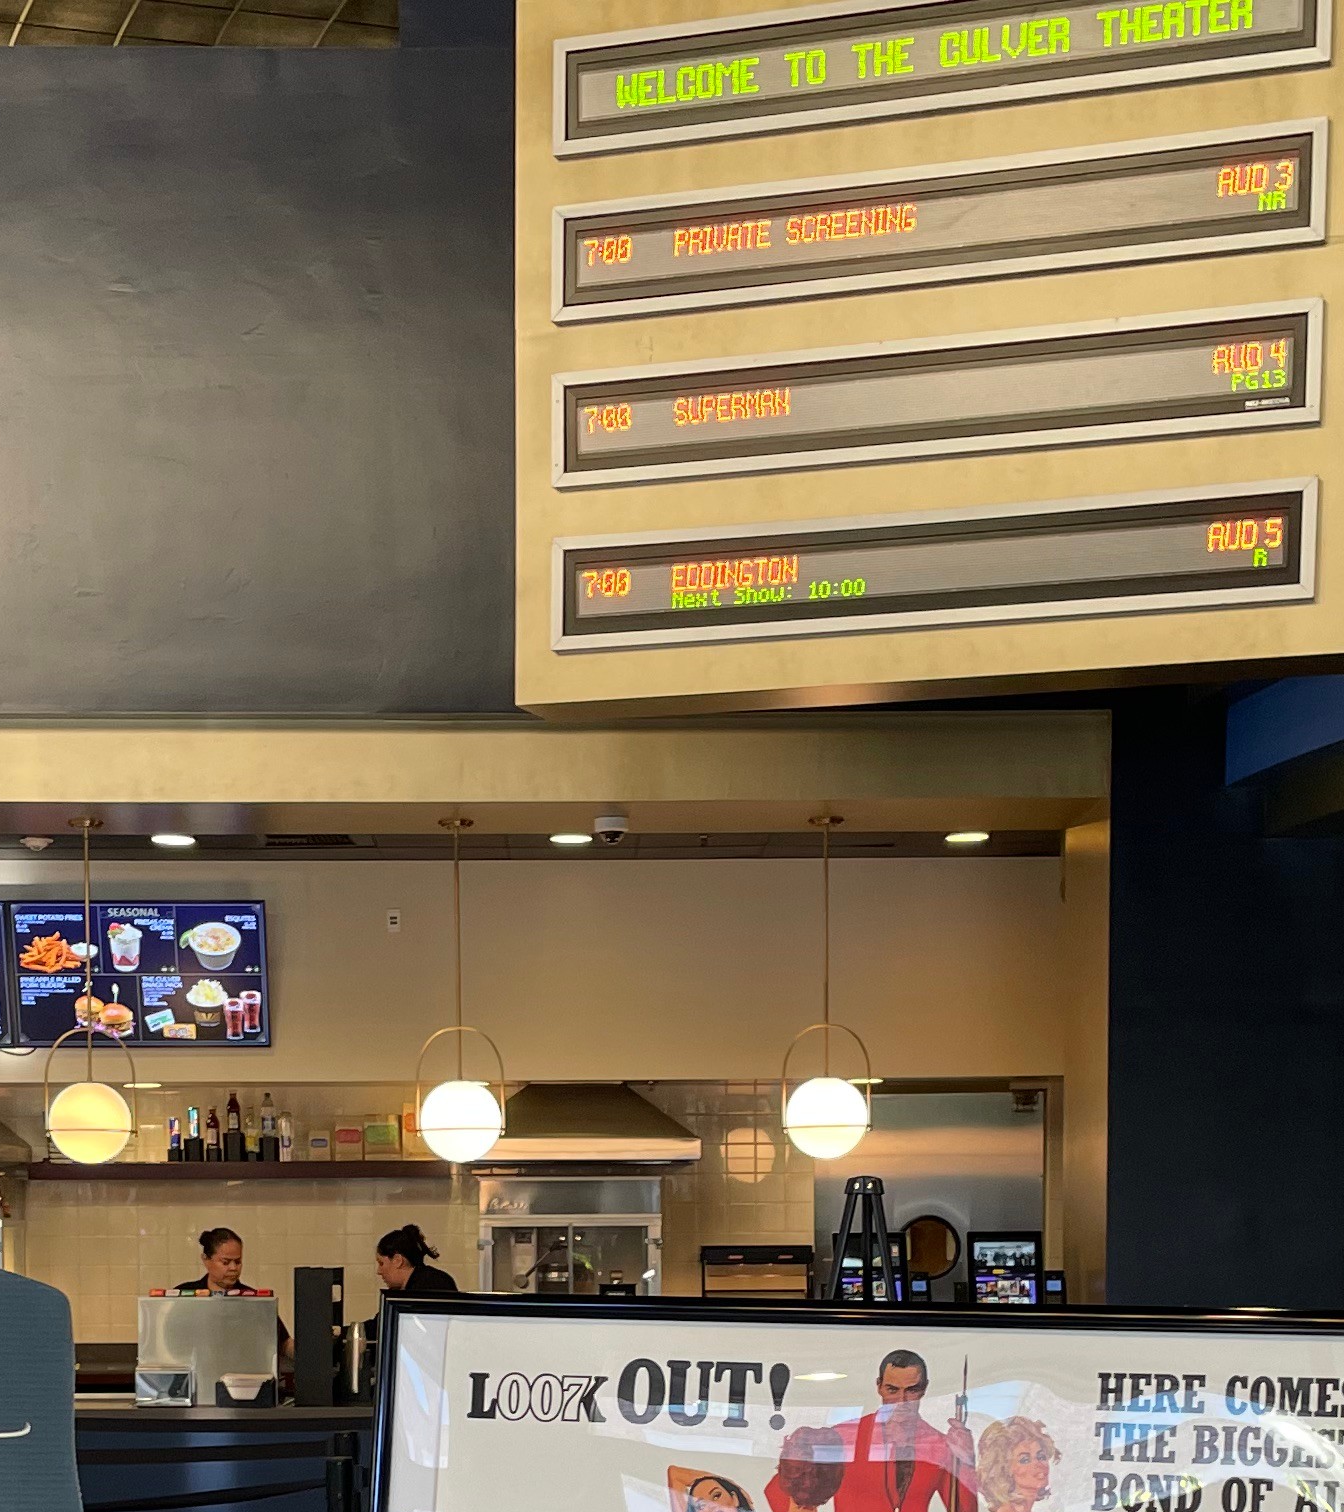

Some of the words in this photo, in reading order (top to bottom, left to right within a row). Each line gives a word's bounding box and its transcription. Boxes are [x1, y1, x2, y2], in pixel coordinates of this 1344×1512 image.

[616, 57, 758, 108] WELCOME
[784, 49, 825, 87] TO
[851, 37, 914, 78] THE
[940, 16, 1071, 68] CULVER
[1096, 0, 1254, 48] THEATER
[1218, 164, 1267, 198] AUD
[1274, 160, 1294, 189] 3
[1258, 191, 1286, 211] NR
[584, 234, 632, 265] 7:00
[673, 221, 771, 256] PRIVATE
[786, 204, 918, 246] SCREENING
[1212, 342, 1262, 375] AUD
[1269, 340, 1287, 367] 4
[1231, 370, 1287, 392] PG13
[583, 403, 632, 433] 7:00
[672, 388, 791, 426] SUPERMAN
[1207, 521, 1258, 552] AUD
[1264, 518, 1284, 548] 5
[582, 569, 632, 599] 7:00
[670, 555, 799, 592] EDDINGTON
[1254, 549, 1268, 567] R
[672, 589, 722, 610] Next
[734, 584, 793, 605] Show:
[808, 578, 866, 599] 10:00
[107, 907, 160, 918] SEASONAL
[617, 1358, 792, 1431] OUT!
[1096, 1372, 1206, 1414] HERE
[1095, 1421, 1178, 1464] THE
